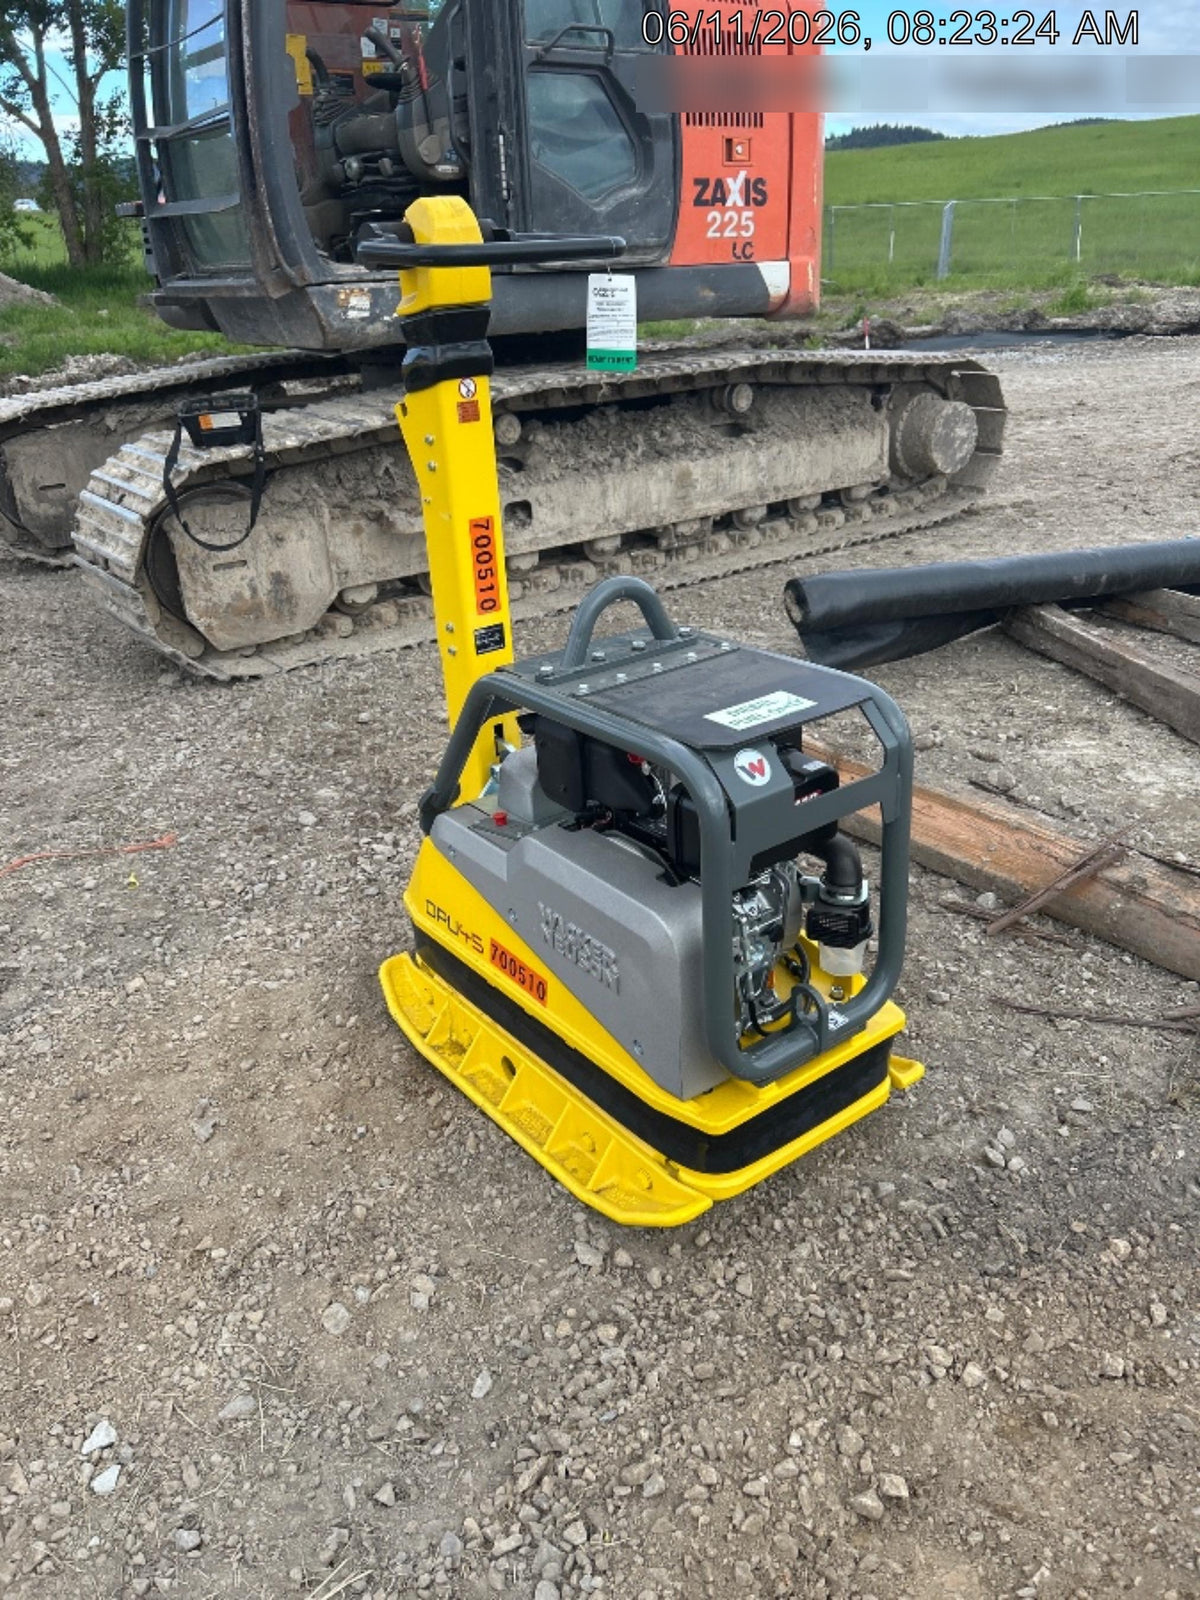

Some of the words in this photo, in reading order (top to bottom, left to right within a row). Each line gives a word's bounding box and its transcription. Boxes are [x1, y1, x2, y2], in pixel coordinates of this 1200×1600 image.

[693, 170, 768, 207] ZAXIS
[706, 210, 755, 238] 225
[732, 241, 754, 260] LC
[473, 519, 497, 612] 700510
[490, 939, 547, 1003] 700510
